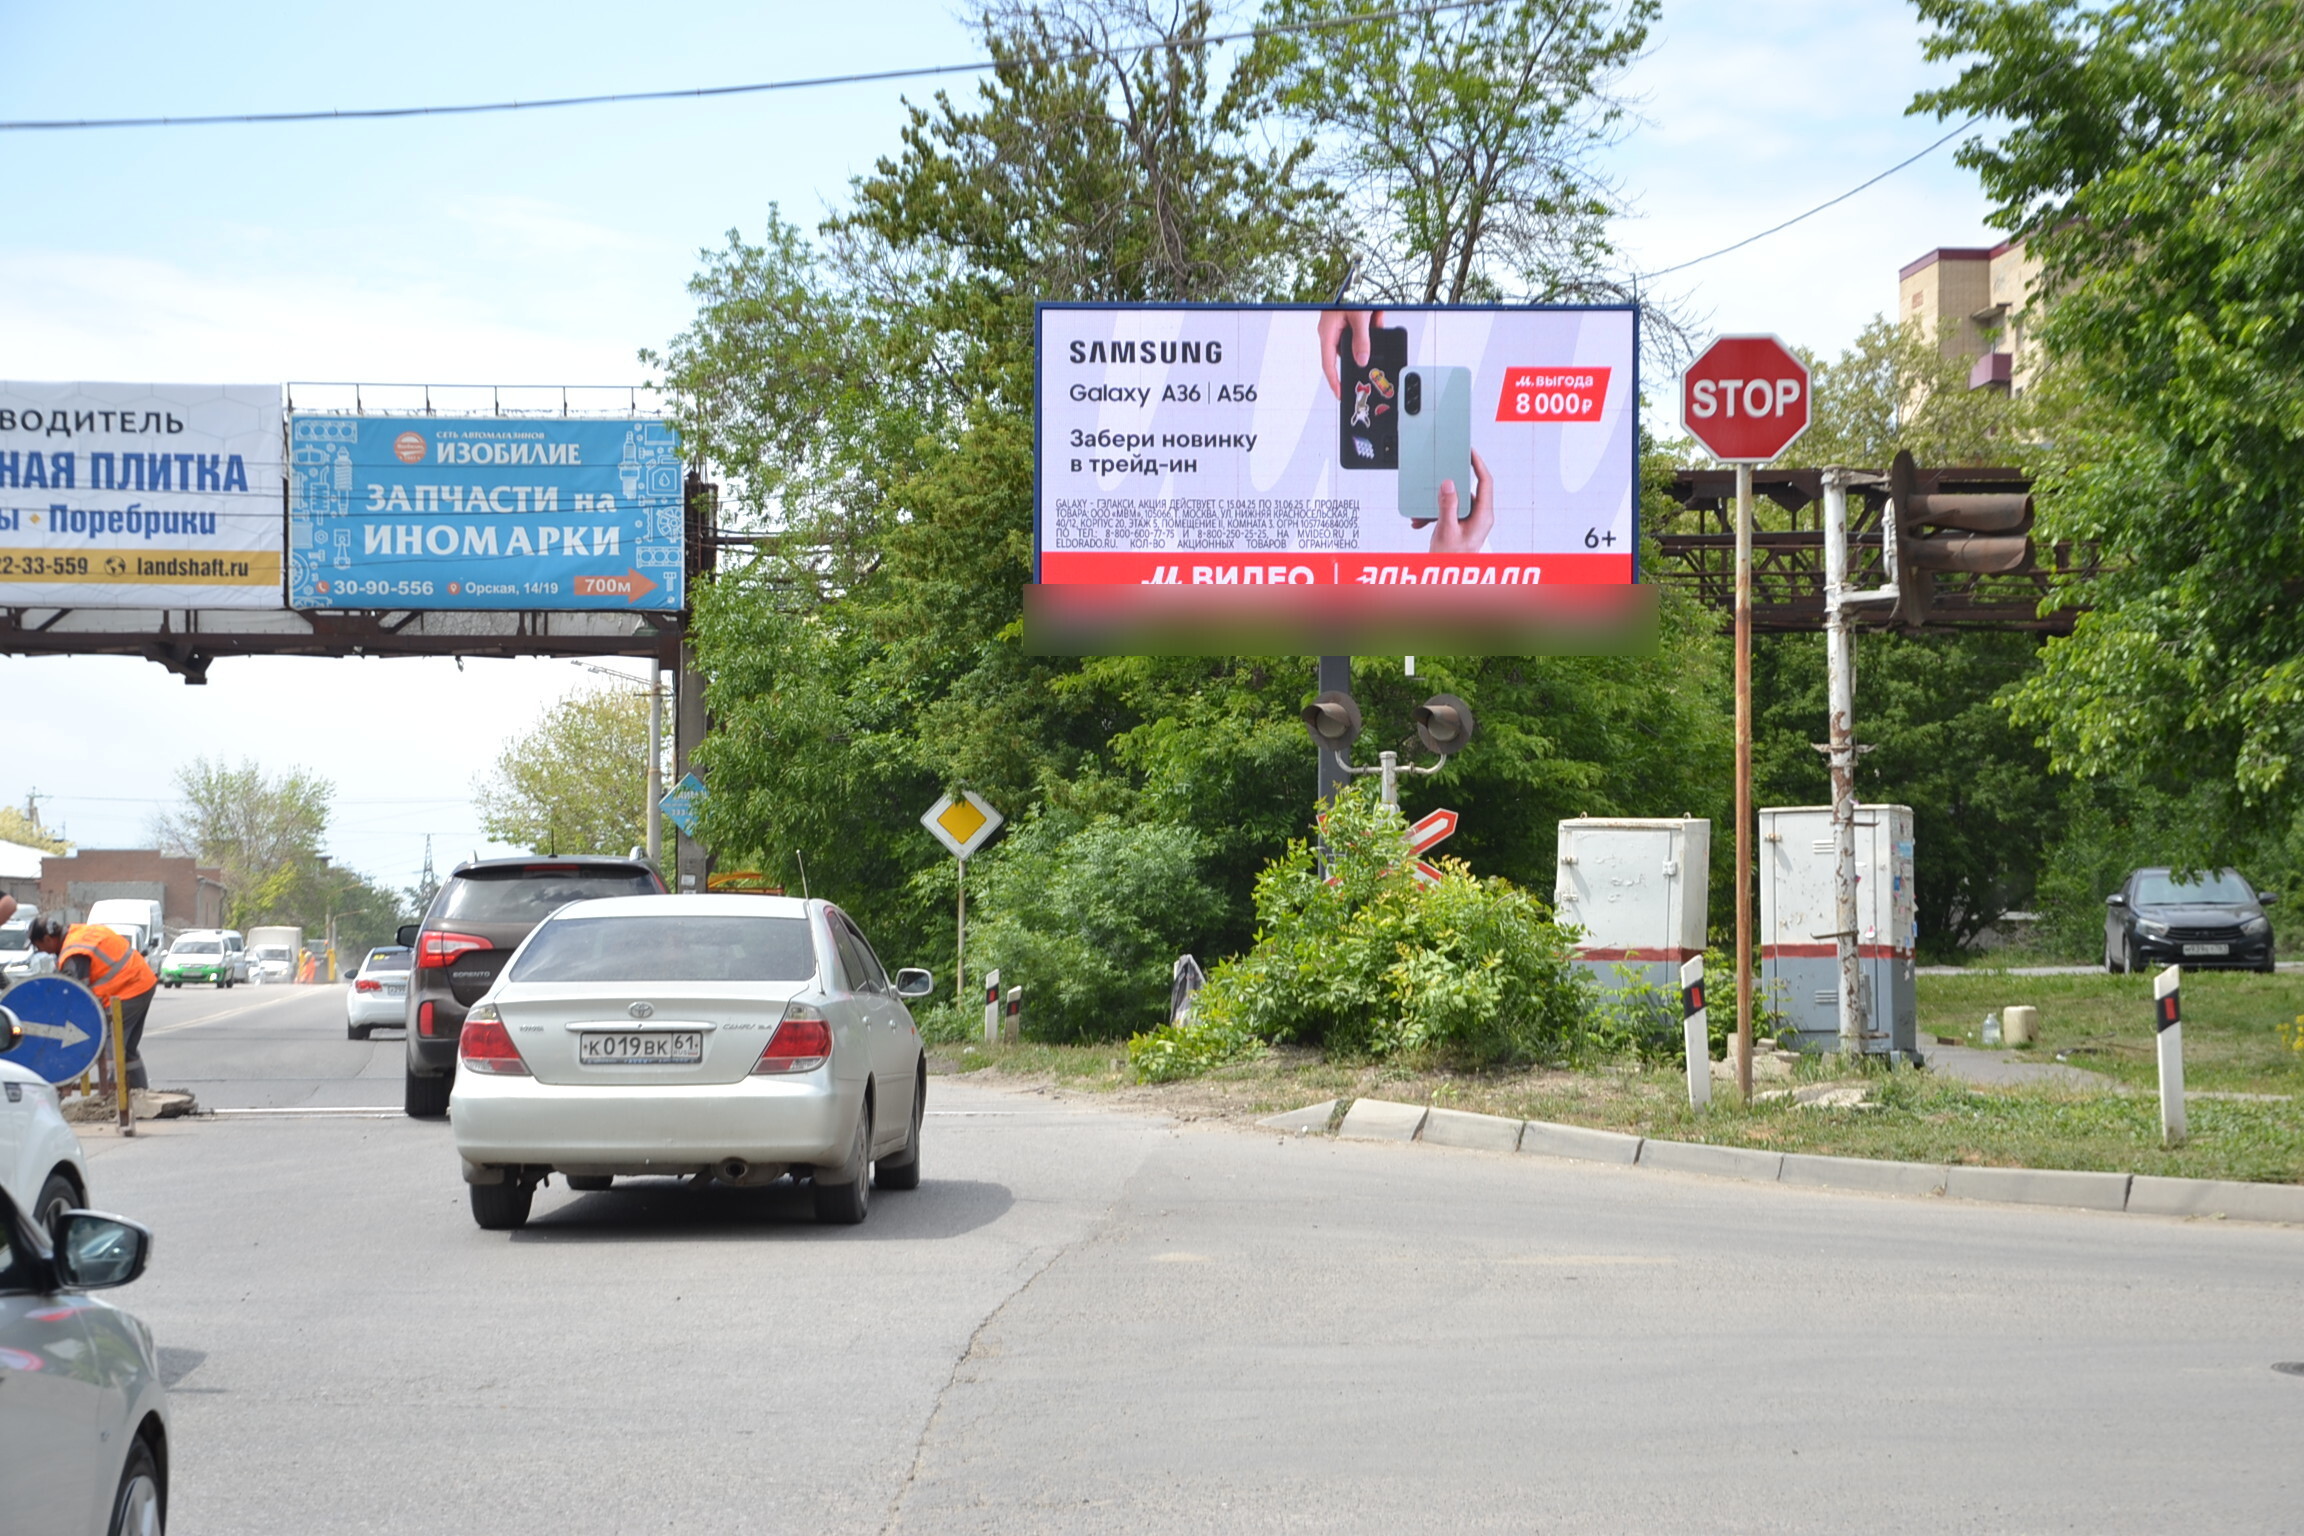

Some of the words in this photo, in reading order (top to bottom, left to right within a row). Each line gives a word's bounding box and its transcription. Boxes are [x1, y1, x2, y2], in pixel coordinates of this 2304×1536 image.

[1069, 340, 1222, 364] SAMSUNG
[1069, 383, 1151, 408] Galaxy
[1162, 384, 1201, 402] A36
[1217, 384, 1258, 402] A56
[1692, 378, 1801, 418] STOP
[436, 431, 459, 439] СЕТЬ
[462, 431, 545, 440] АВТОМАГАЗИНОВ
[1070, 429, 1155, 450] Забери
[1162, 433, 1258, 452] новинку
[436, 442, 582, 465] ИЗОБИЛИЕ
[91, 452, 249, 492] ПЛИТКА
[1070, 459, 1082, 473] в
[1089, 454, 1198, 477] трейд-ин
[366, 483, 559, 513] ЗАПЧАСТИ
[574, 490, 618, 513] на
[1055, 499, 1088, 509] GALAXY
[1138, 499, 1167, 511] АКЦИЯ
[1169, 498, 1216, 510] ДЕЙСТВУЕТ
[1259, 499, 1272, 509] ПО
[1314, 499, 1360, 511] ПРОДАВЕЦ
[50, 503, 216, 539] Поребрики
[1080, 519, 1113, 529] КОРПУС
[1128, 519, 1151, 529] ЭТАЖ
[1161, 519, 1216, 530] ПОМЕЩЕНИЕ
[1227, 519, 1267, 529] КОМНАТА
[1276, 519, 1299, 529] ОГРН
[1234, 509, 1272, 519] НИЖНЯЯ
[363, 524, 621, 556] ИНОМАРКИ
[1056, 529, 1070, 538] ПО
[1105, 529, 1175, 538] 8-800-600-77-75
[1182, 529, 1190, 538] И
[1276, 529, 1290, 538] НА
[1352, 529, 1360, 538] И
[1584, 527, 1617, 549] 6+
[1130, 539, 1166, 549] КОЛ-ВО
[1177, 539, 1235, 550] АКЦИОННЫХ
[1246, 539, 1287, 549] ТОВАРОВ
[0, 556, 88, 575] 2-33-559
[137, 557, 249, 577] landshaft.ru
[334, 580, 434, 596] 30-90-556
[465, 581, 518, 597] Орская,
[523, 581, 559, 595] 14/19
[585, 578, 632, 593] 700м
[452, 970, 491, 978] SORENTO
[674, 1035, 694, 1050] 61
